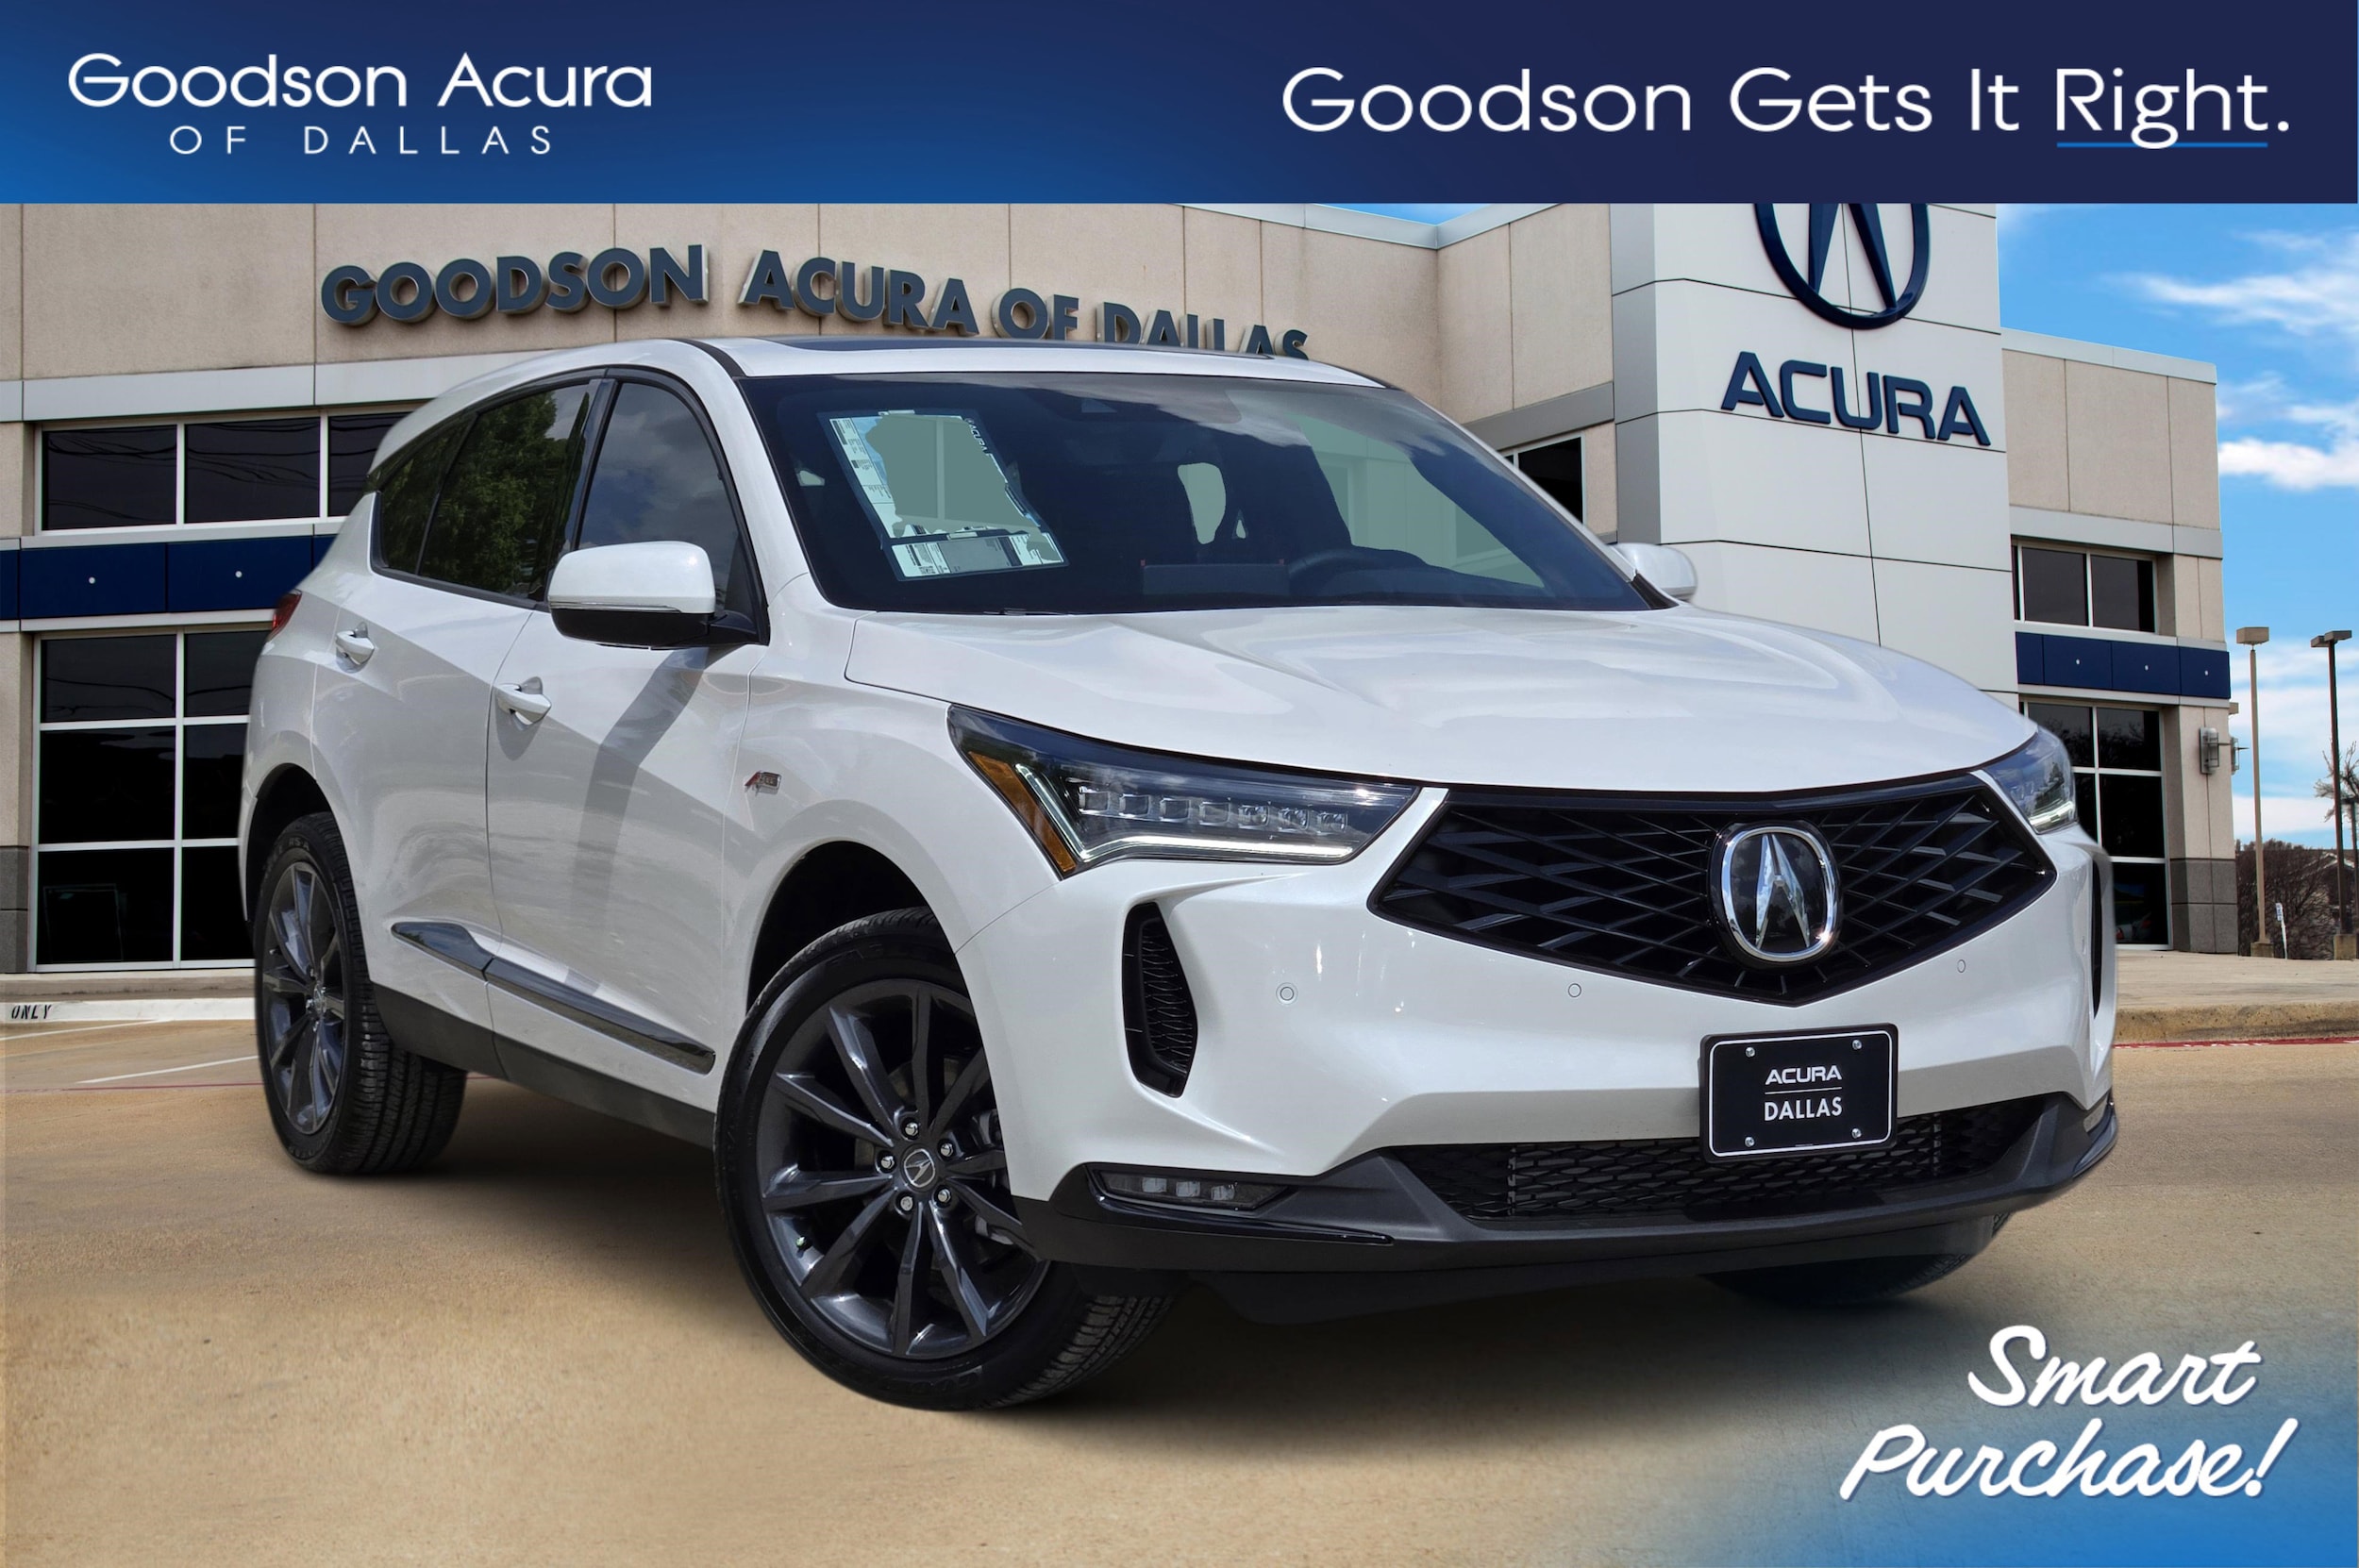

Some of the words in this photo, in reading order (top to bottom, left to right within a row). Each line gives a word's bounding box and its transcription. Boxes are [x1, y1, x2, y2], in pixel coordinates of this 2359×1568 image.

[320, 244, 709, 325] GOODSON
[738, 249, 979, 337] ACURA
[992, 288, 1079, 340] OF
[1720, 351, 1991, 446] ACURA
[11, 1004, 52, 1020] ONLY
[1765, 1064, 1843, 1086] ACURA
[1764, 1096, 1843, 1122] DALLAS
